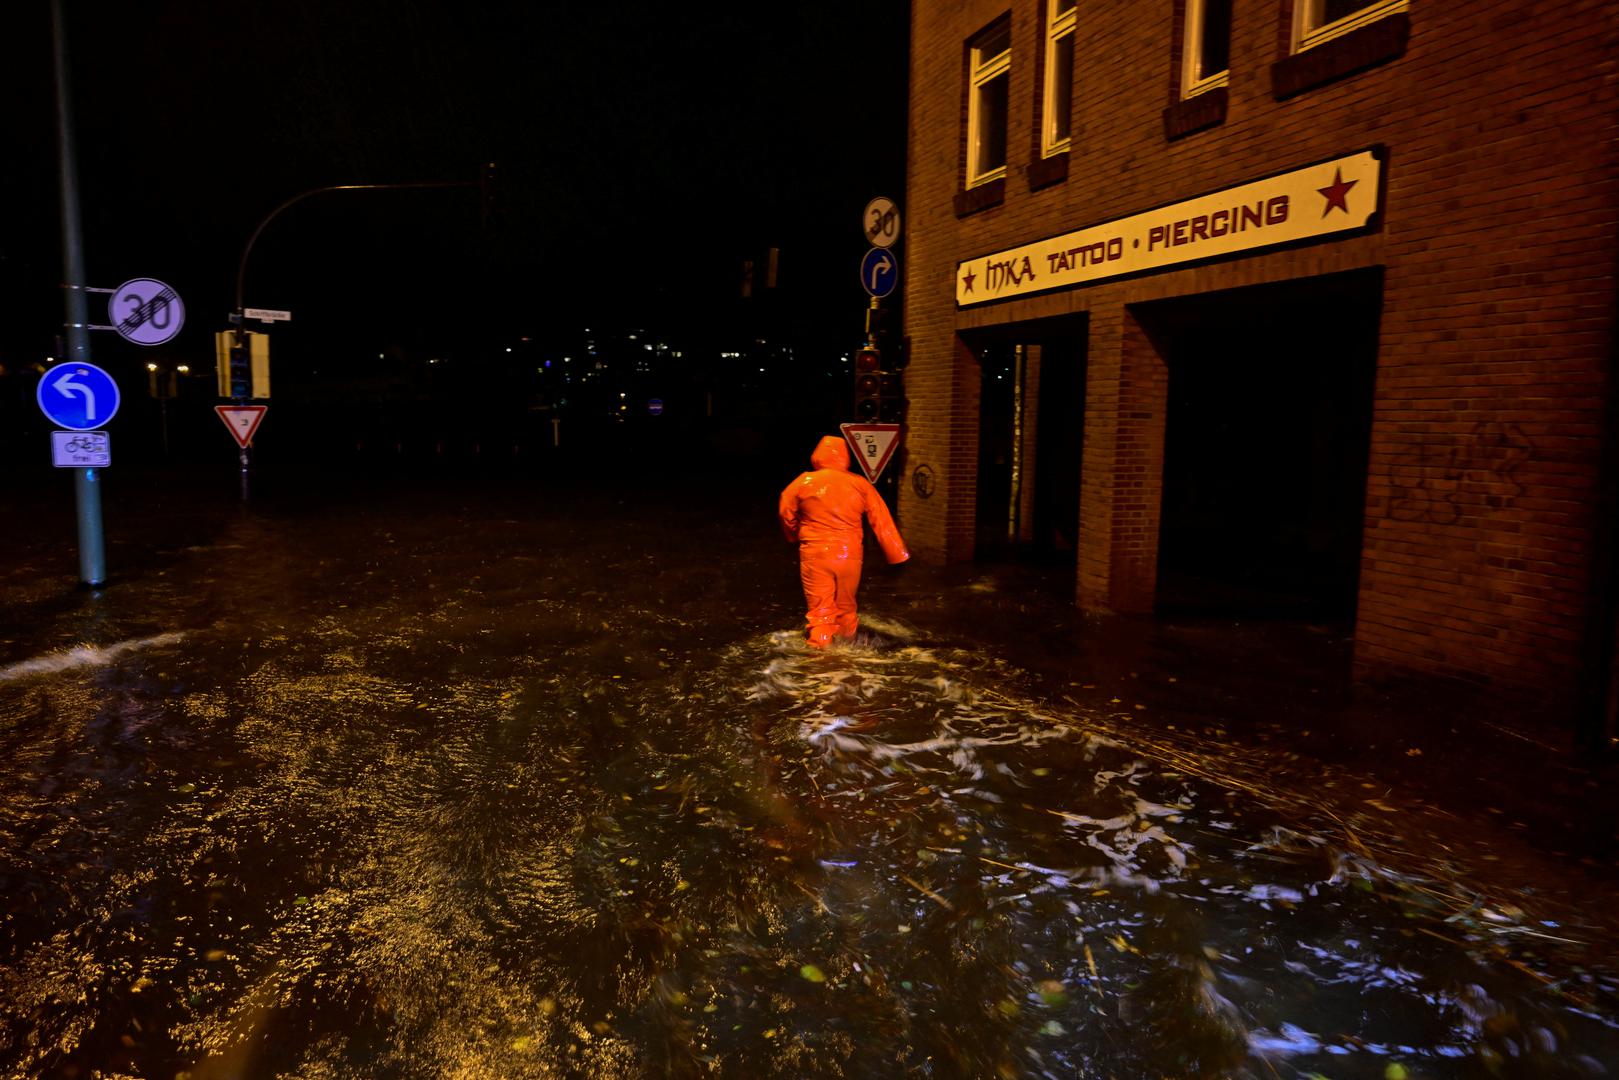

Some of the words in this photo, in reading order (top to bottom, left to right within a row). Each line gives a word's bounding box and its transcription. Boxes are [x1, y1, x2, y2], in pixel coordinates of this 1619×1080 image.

[871, 208, 895, 238] 30
[1047, 237, 1122, 274] TATTOO
[1148, 195, 1289, 251] PIERCING
[123, 294, 170, 330] 30
